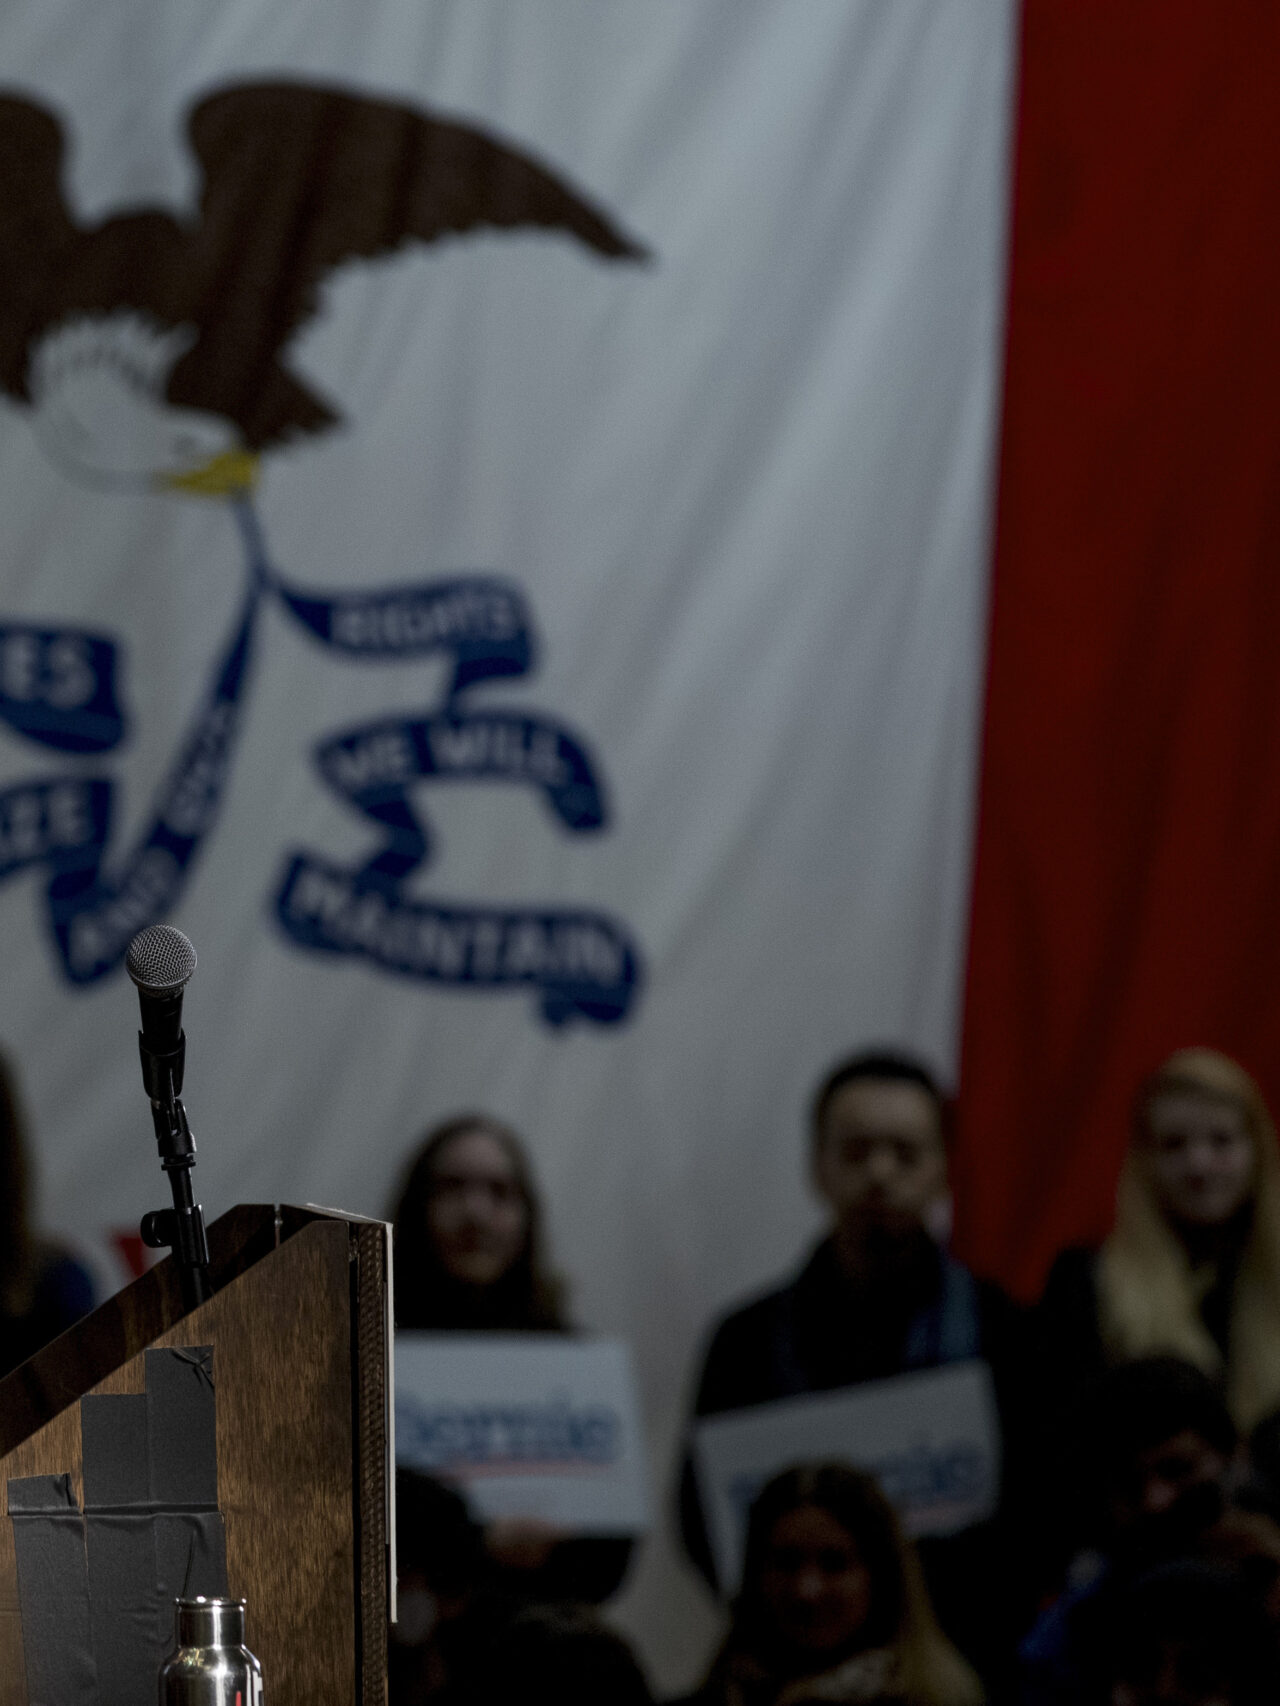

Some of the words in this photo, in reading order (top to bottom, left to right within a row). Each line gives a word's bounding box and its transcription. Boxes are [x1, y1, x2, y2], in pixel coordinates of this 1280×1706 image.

[322, 728, 412, 787] WE
[428, 718, 568, 788] WILL
[288, 864, 623, 990] MAINTAIN
